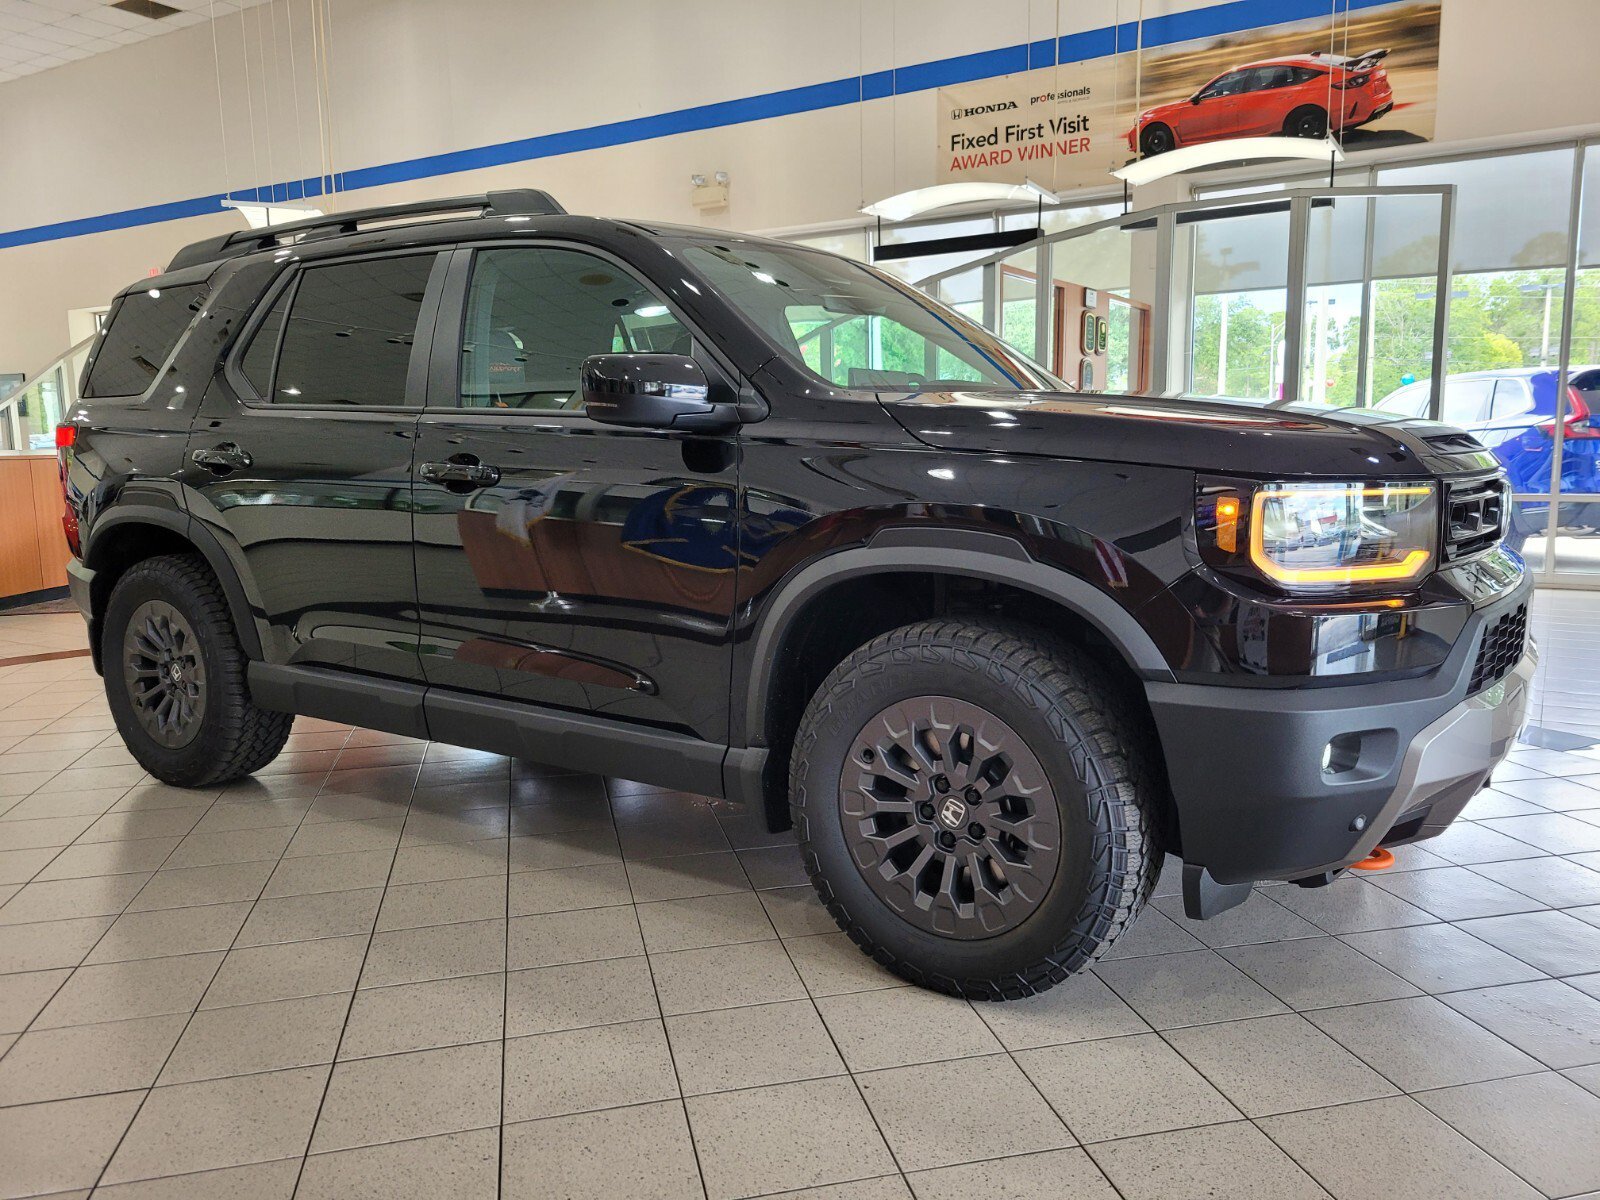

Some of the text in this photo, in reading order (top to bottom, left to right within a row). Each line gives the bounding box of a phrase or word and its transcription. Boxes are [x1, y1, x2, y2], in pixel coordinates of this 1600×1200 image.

[964, 101, 1019, 117] HONDA
[951, 115, 1090, 151] Fixed First Visit
[950, 137, 1091, 171] AWARD WINNER
